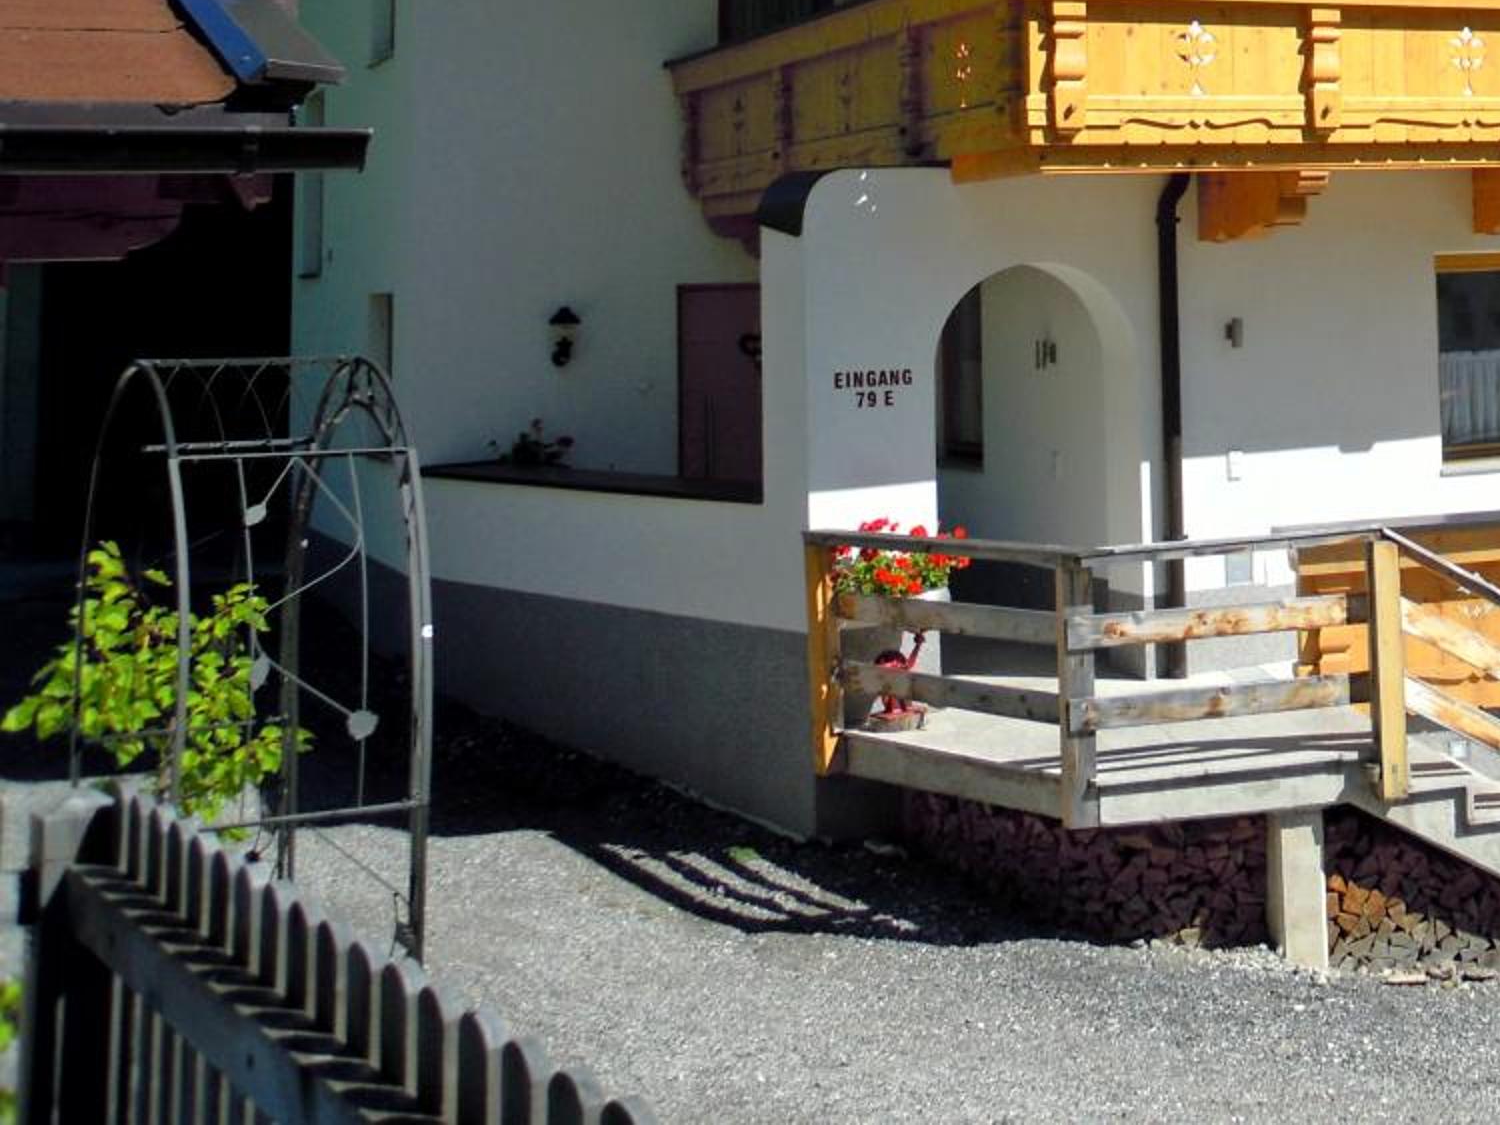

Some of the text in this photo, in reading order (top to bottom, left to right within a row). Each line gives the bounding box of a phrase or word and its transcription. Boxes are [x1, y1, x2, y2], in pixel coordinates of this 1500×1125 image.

[834, 369, 912, 389] EINGANG
[856, 390, 894, 408] 79 E
